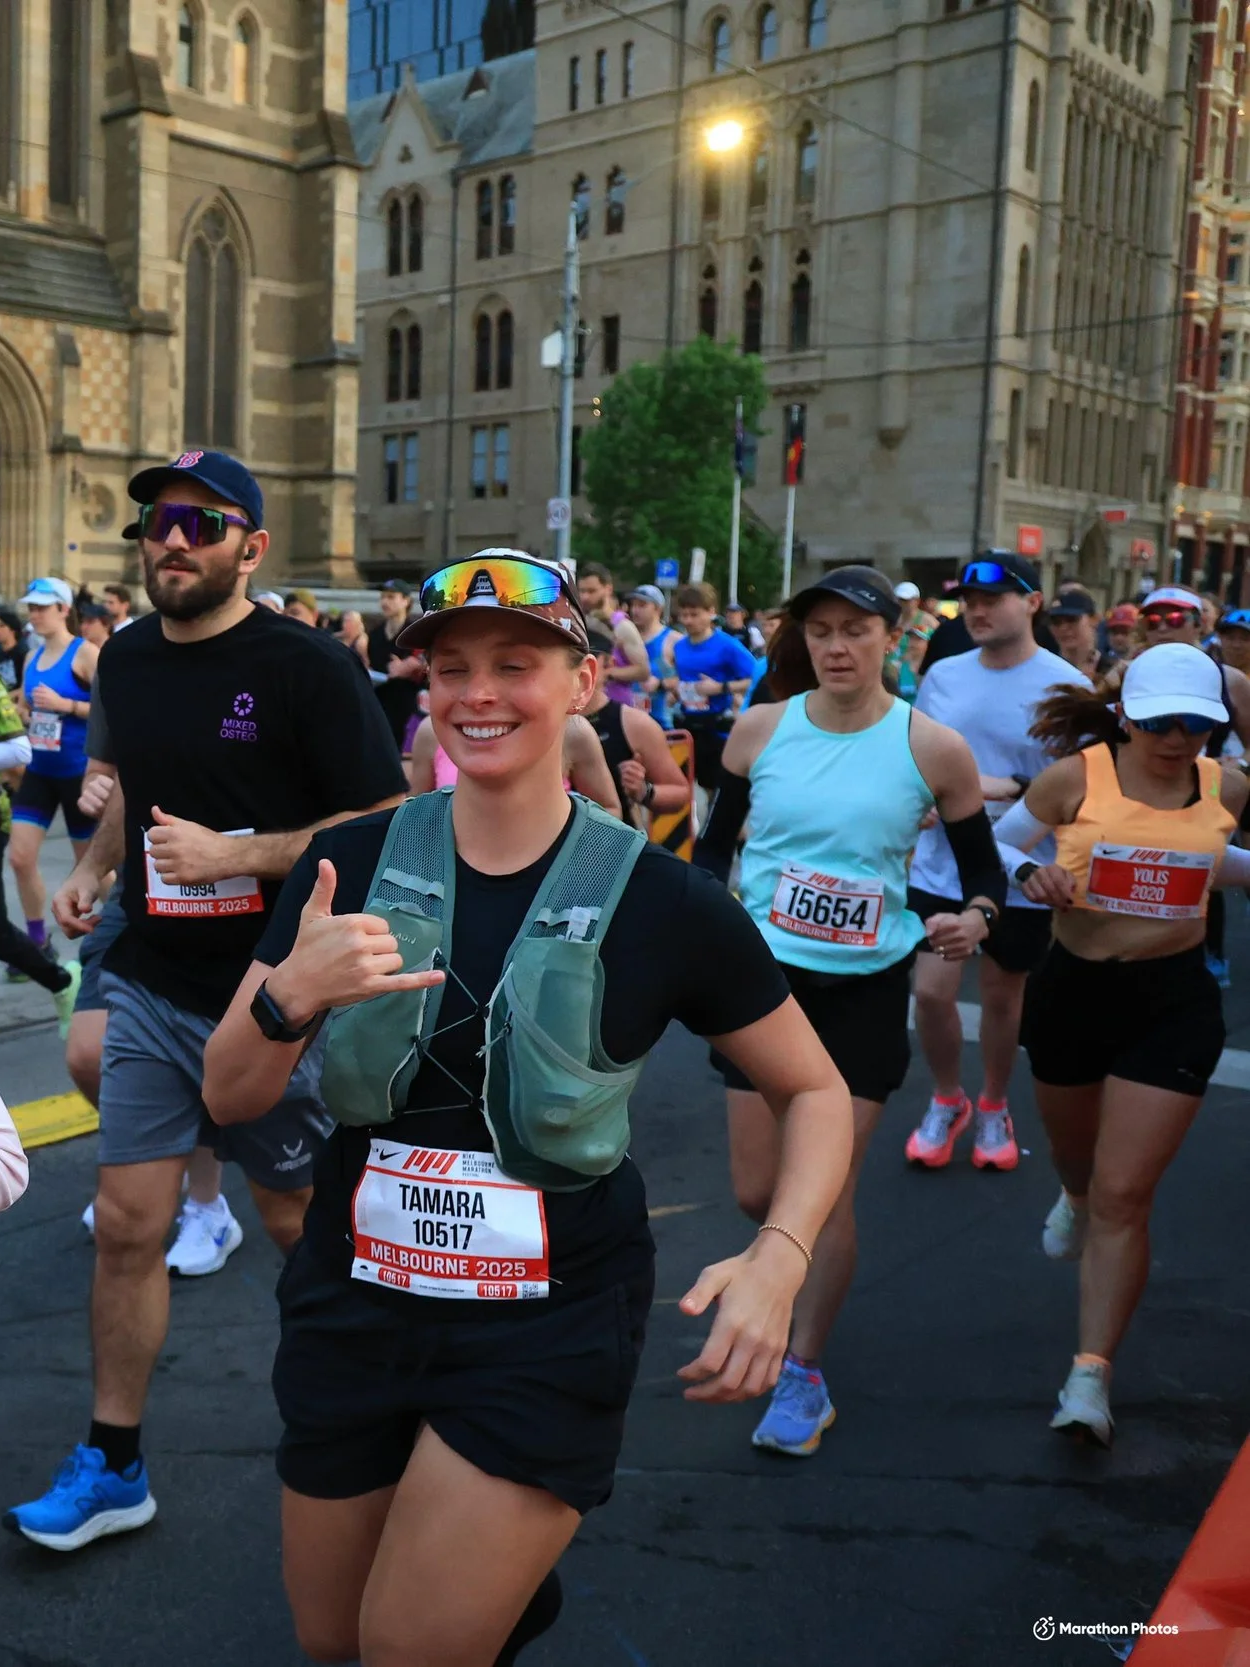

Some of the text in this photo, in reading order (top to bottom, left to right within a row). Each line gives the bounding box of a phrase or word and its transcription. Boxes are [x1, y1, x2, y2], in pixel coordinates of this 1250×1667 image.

[222, 718, 257, 731] MIXED
[220, 728, 257, 741] OSTEO
[1133, 867, 1170, 885] YOLIS
[179, 883, 217, 897] 10994
[1130, 885, 1166, 902] 2020
[156, 899, 250, 914] MELBOURNE 2025
[787, 884, 870, 931] 15654
[776, 915, 833, 940] MELBOURNE
[398, 1183, 486, 1220] TAMARA
[412, 1218, 474, 1251] 10517
[370, 1241, 527, 1278] MELBOURNE 2025
[382, 1270, 408, 1286] 10517
[483, 1284, 513, 1297] 10517
